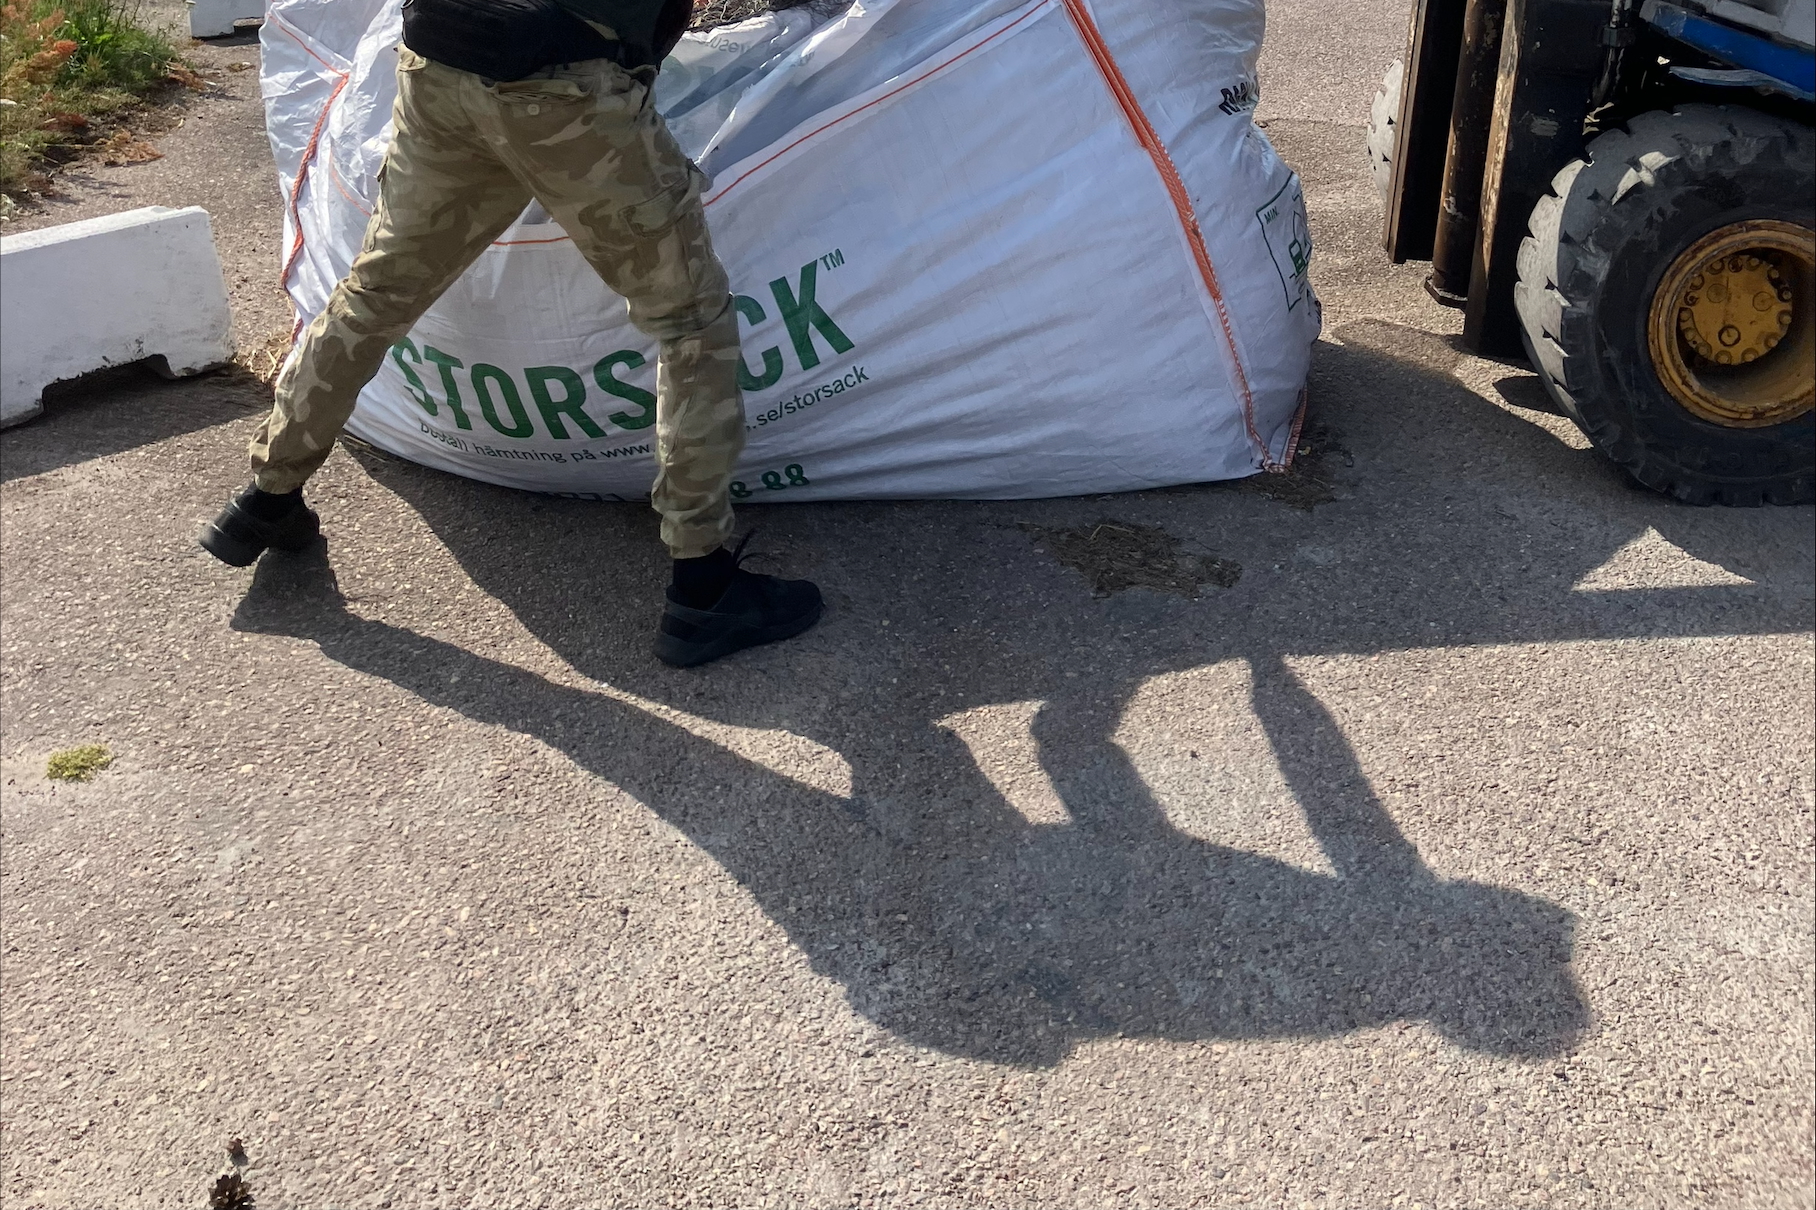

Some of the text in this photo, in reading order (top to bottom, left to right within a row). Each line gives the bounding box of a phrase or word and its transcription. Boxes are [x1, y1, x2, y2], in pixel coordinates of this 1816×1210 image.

[391, 259, 855, 440] STORSCK
[472, 442, 566, 464] hämtning
[571, 448, 597, 463] på
